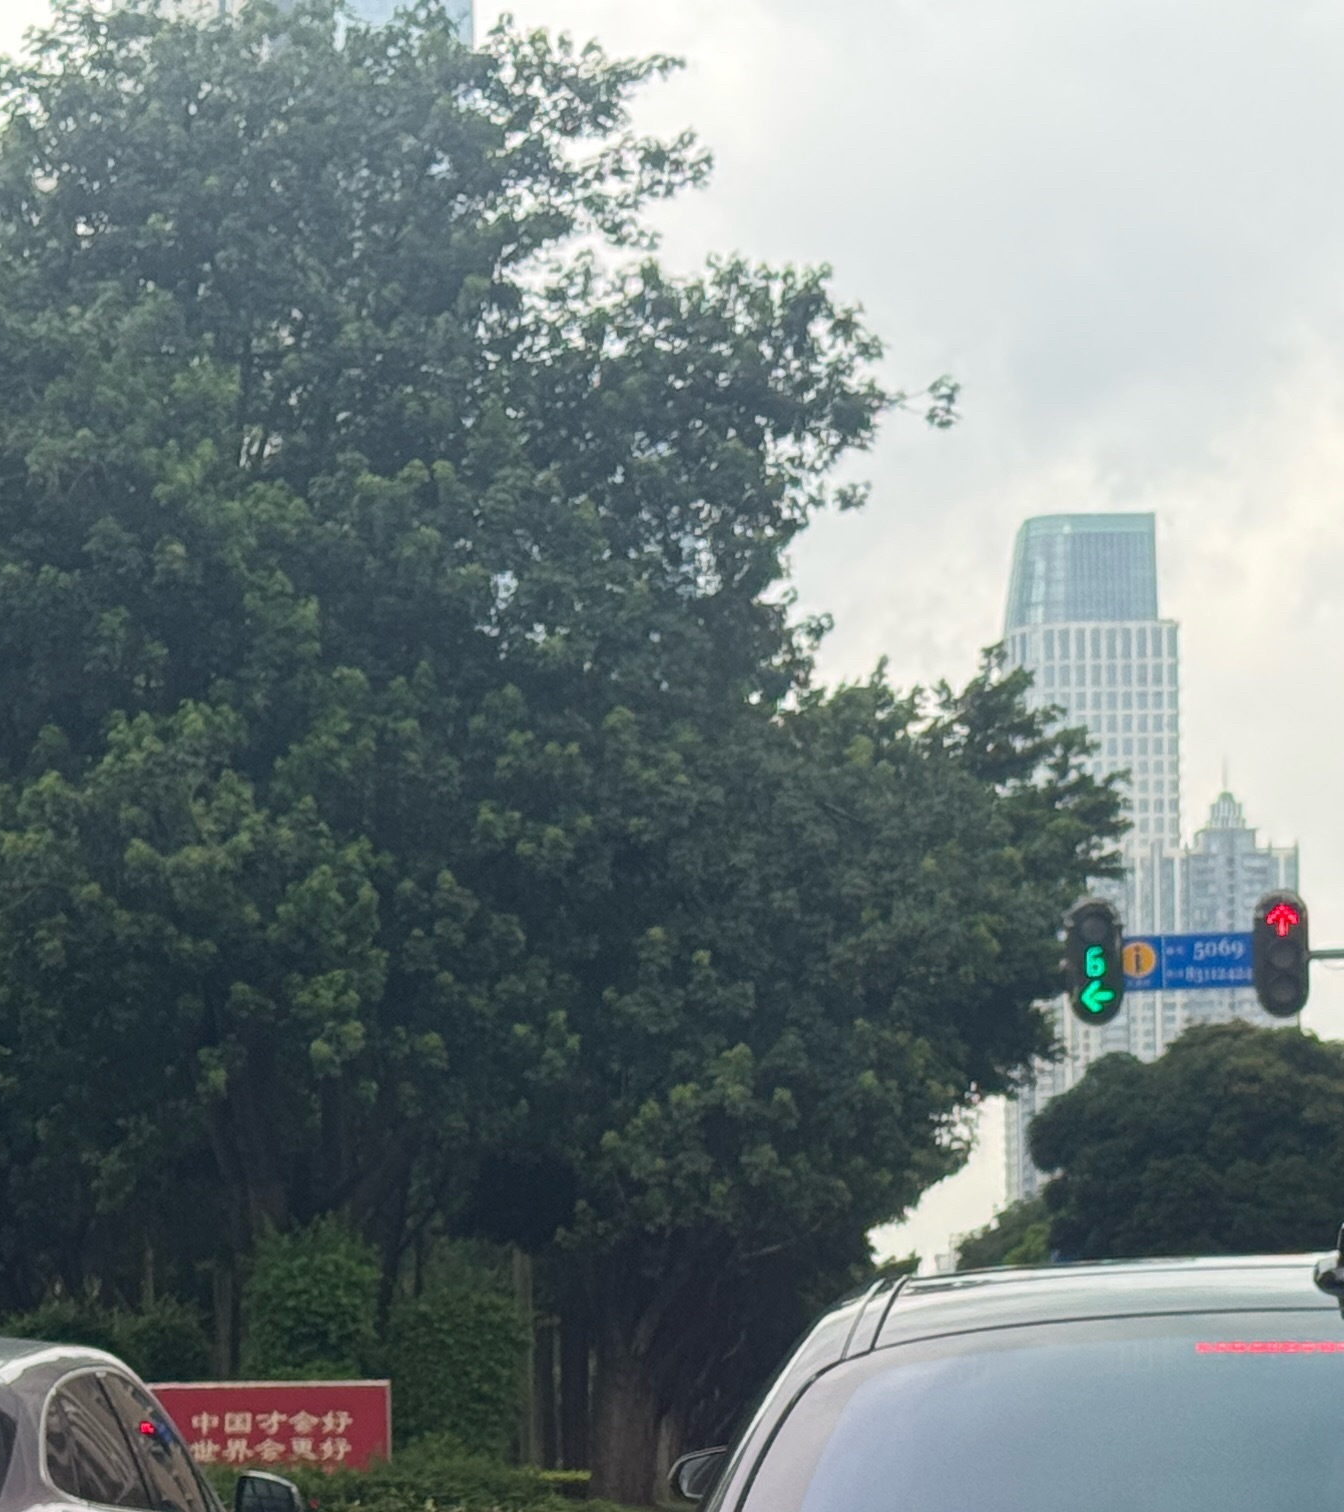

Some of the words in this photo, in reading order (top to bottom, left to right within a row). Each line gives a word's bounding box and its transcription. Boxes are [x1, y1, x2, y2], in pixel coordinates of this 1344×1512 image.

[1085, 945, 1105, 978] 6
[191, 1410, 354, 1436] 中国才会好
[189, 1437, 353, 1463] 世界会更好
